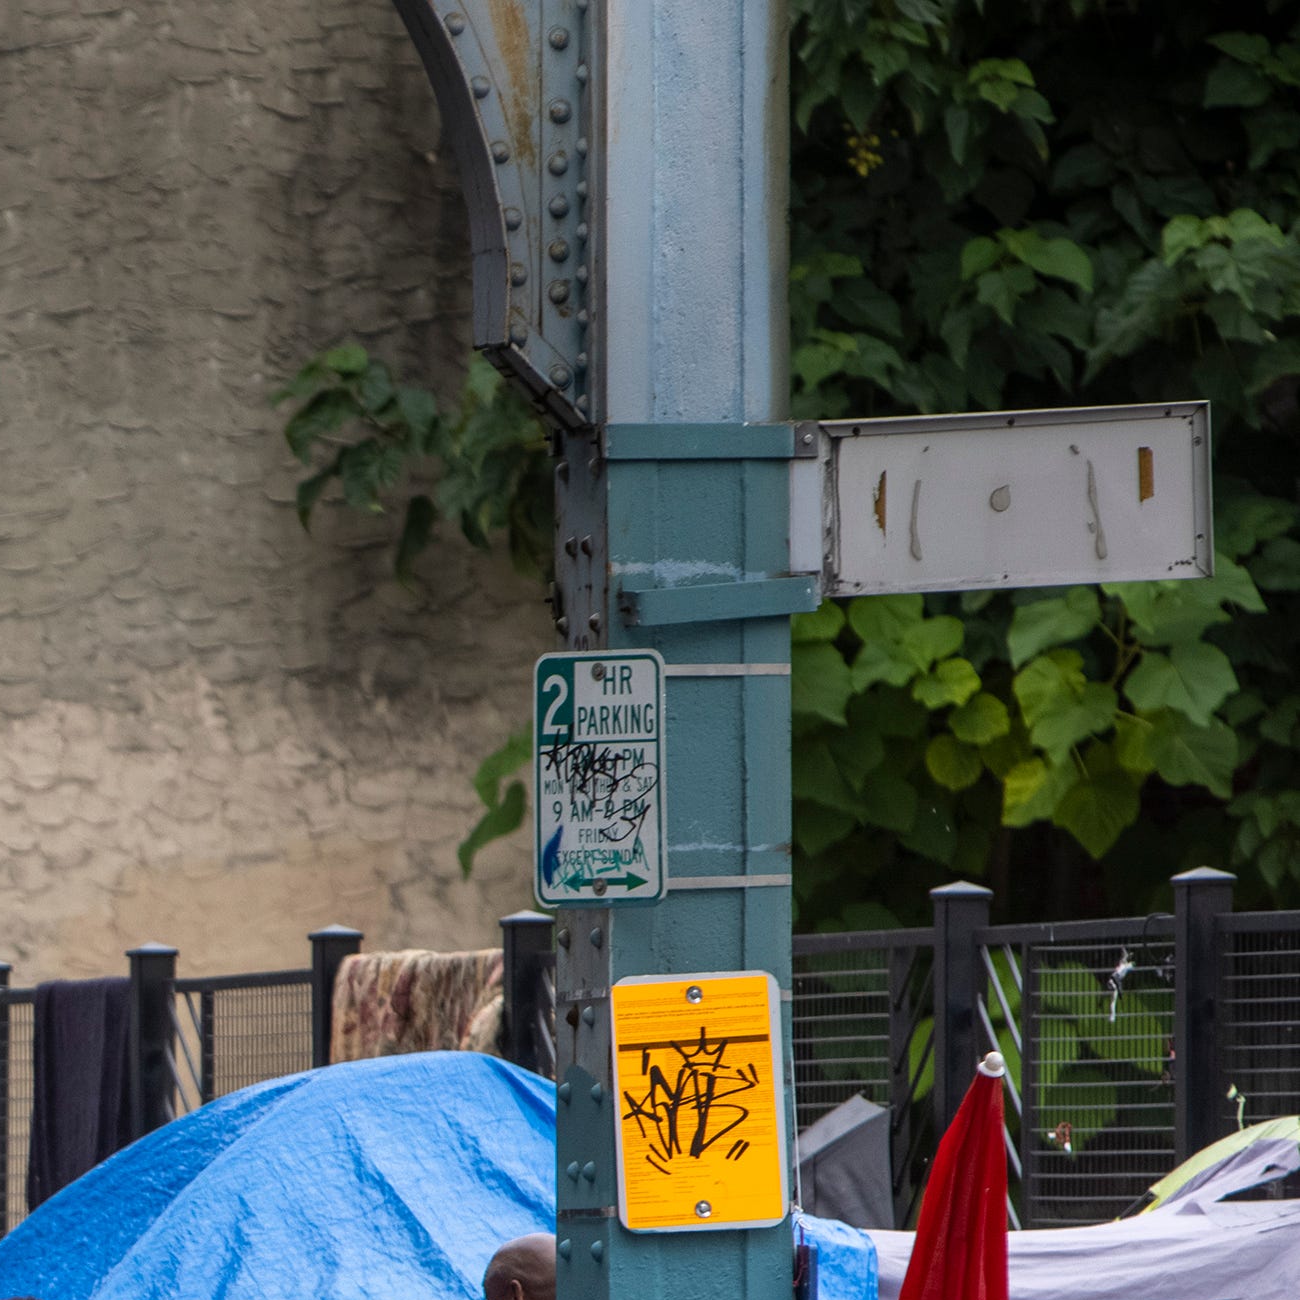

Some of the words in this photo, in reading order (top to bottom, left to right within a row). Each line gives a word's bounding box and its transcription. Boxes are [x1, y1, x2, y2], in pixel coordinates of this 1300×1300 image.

[542, 674, 569, 735] 2
[603, 665, 633, 696] HR
[577, 703, 654, 736] PARKING
[622, 748, 645, 771] PM
[544, 780, 564, 795] MON
[637, 776, 653, 792] SAT
[552, 801, 563, 823] 9
[623, 798, 645, 818] PM
[578, 828, 619, 844] FRIDAY
[557, 850, 599, 866] EXCEPT
